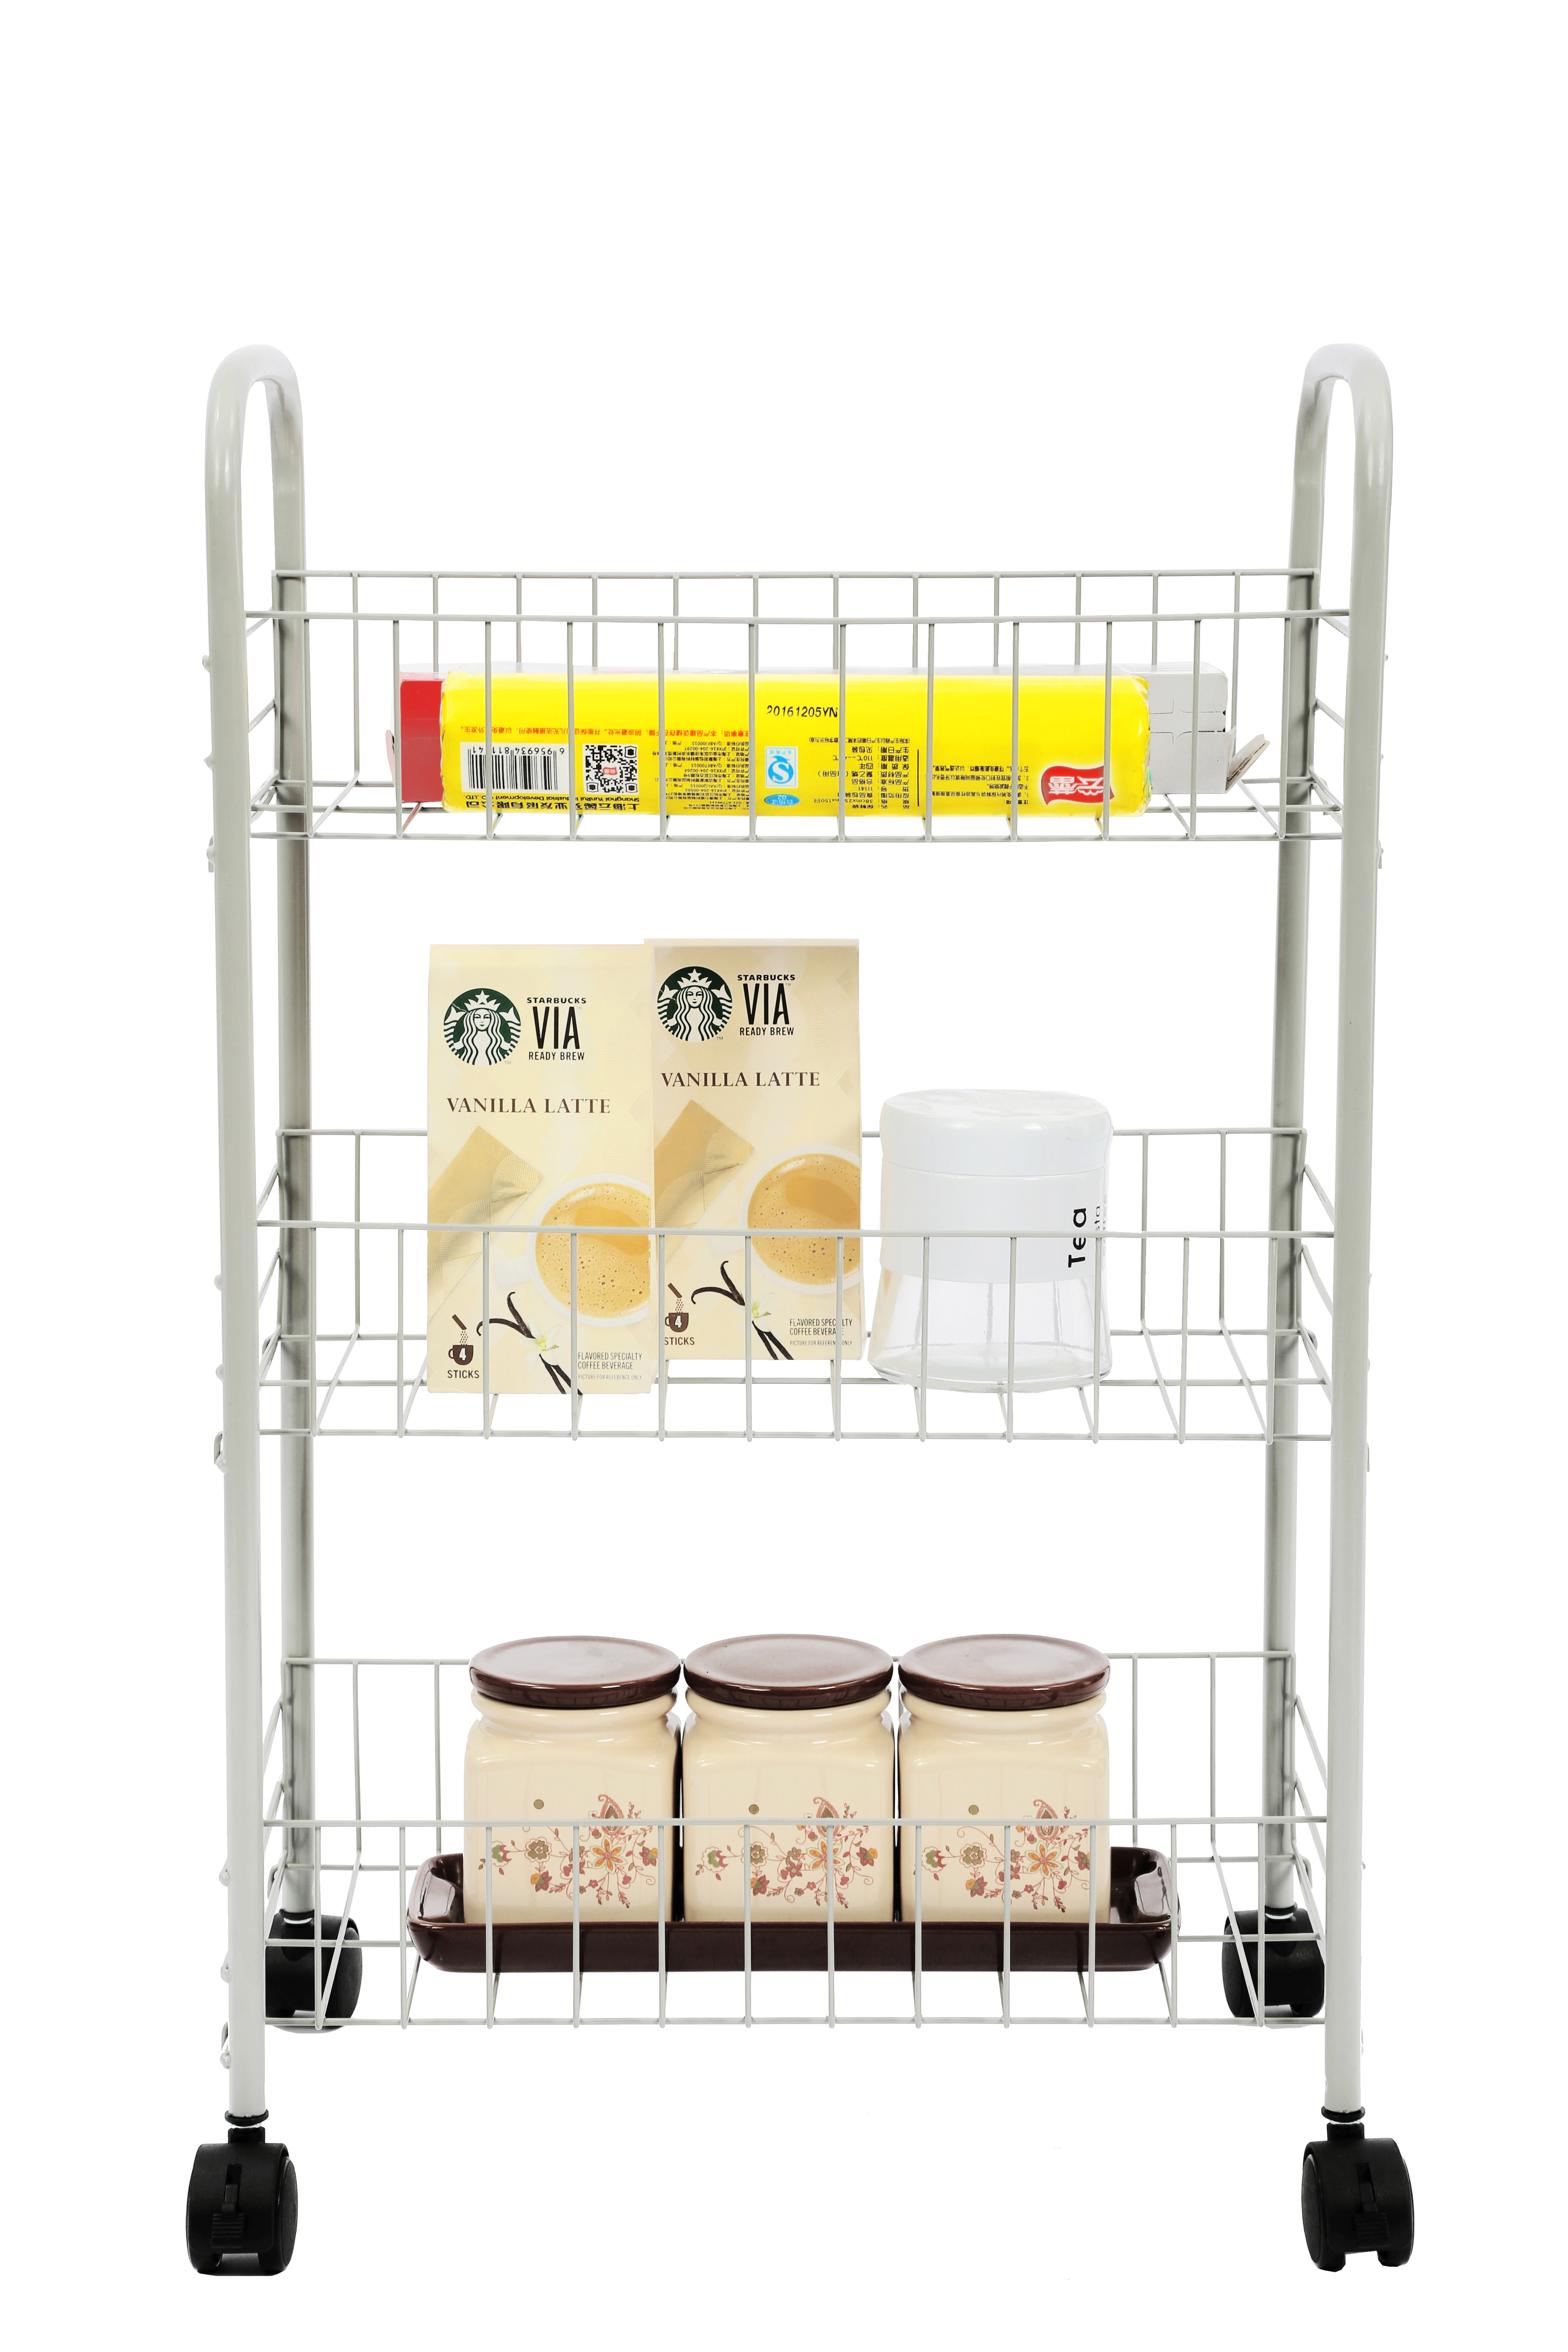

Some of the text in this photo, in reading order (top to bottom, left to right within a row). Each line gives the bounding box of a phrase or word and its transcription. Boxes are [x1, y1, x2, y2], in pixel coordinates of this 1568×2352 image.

[472, 745, 510, 755] 81141
[743, 983, 790, 1025] VIA
[532, 1007, 580, 1049] VIA
[740, 1027, 794, 1036] READY BREW
[529, 1052, 584, 1060] READY BREW
[661, 1072, 820, 1087] VANILLA LATTE
[447, 1098, 610, 1113] VANILLA LATTE
[1068, 1208, 1086, 1268] Tea
[675, 1316, 682, 1328] 4
[459, 1348, 466, 1361] 4
[448, 1370, 479, 1379] STICKS
